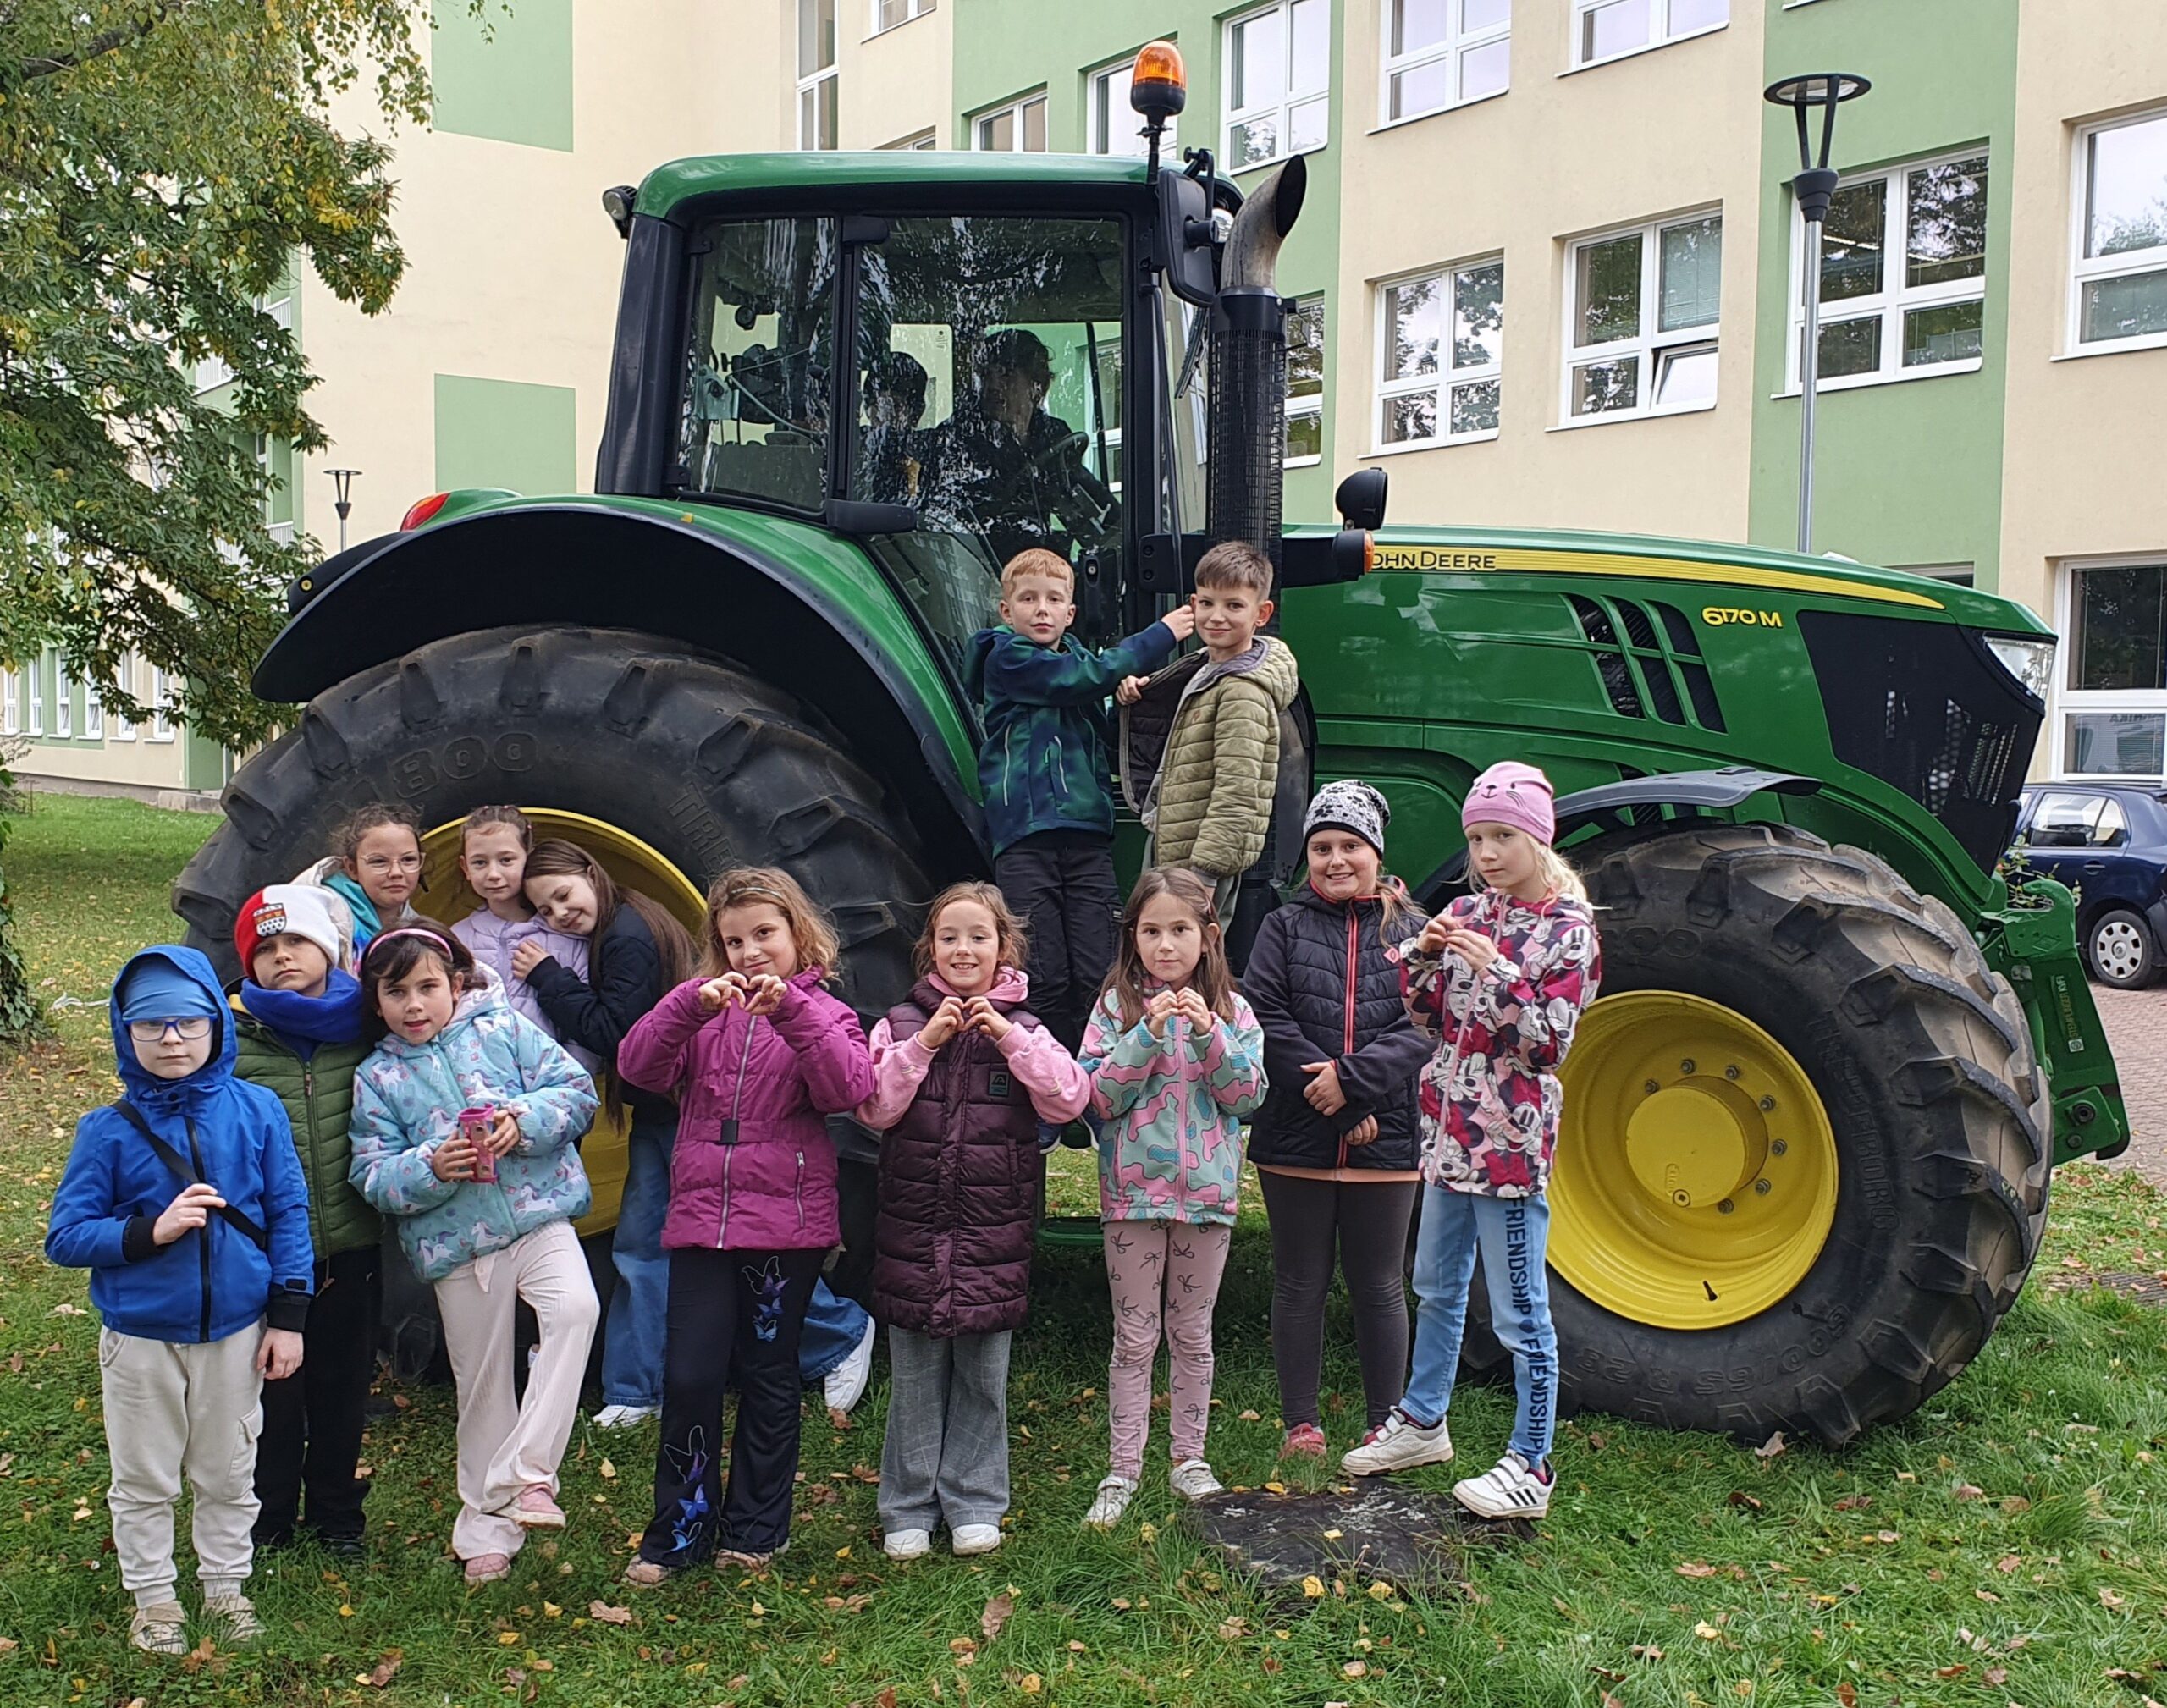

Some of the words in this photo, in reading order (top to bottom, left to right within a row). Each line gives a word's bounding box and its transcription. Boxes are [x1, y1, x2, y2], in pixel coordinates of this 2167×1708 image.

[1373, 553, 1415, 567] OHN
[1421, 551, 1496, 569] DEERE
[388, 730, 540, 799] 800
[1505, 1196, 1531, 1320] FRIENDSHIP
[1520, 1338, 1548, 1451] FRIENDSHIP
